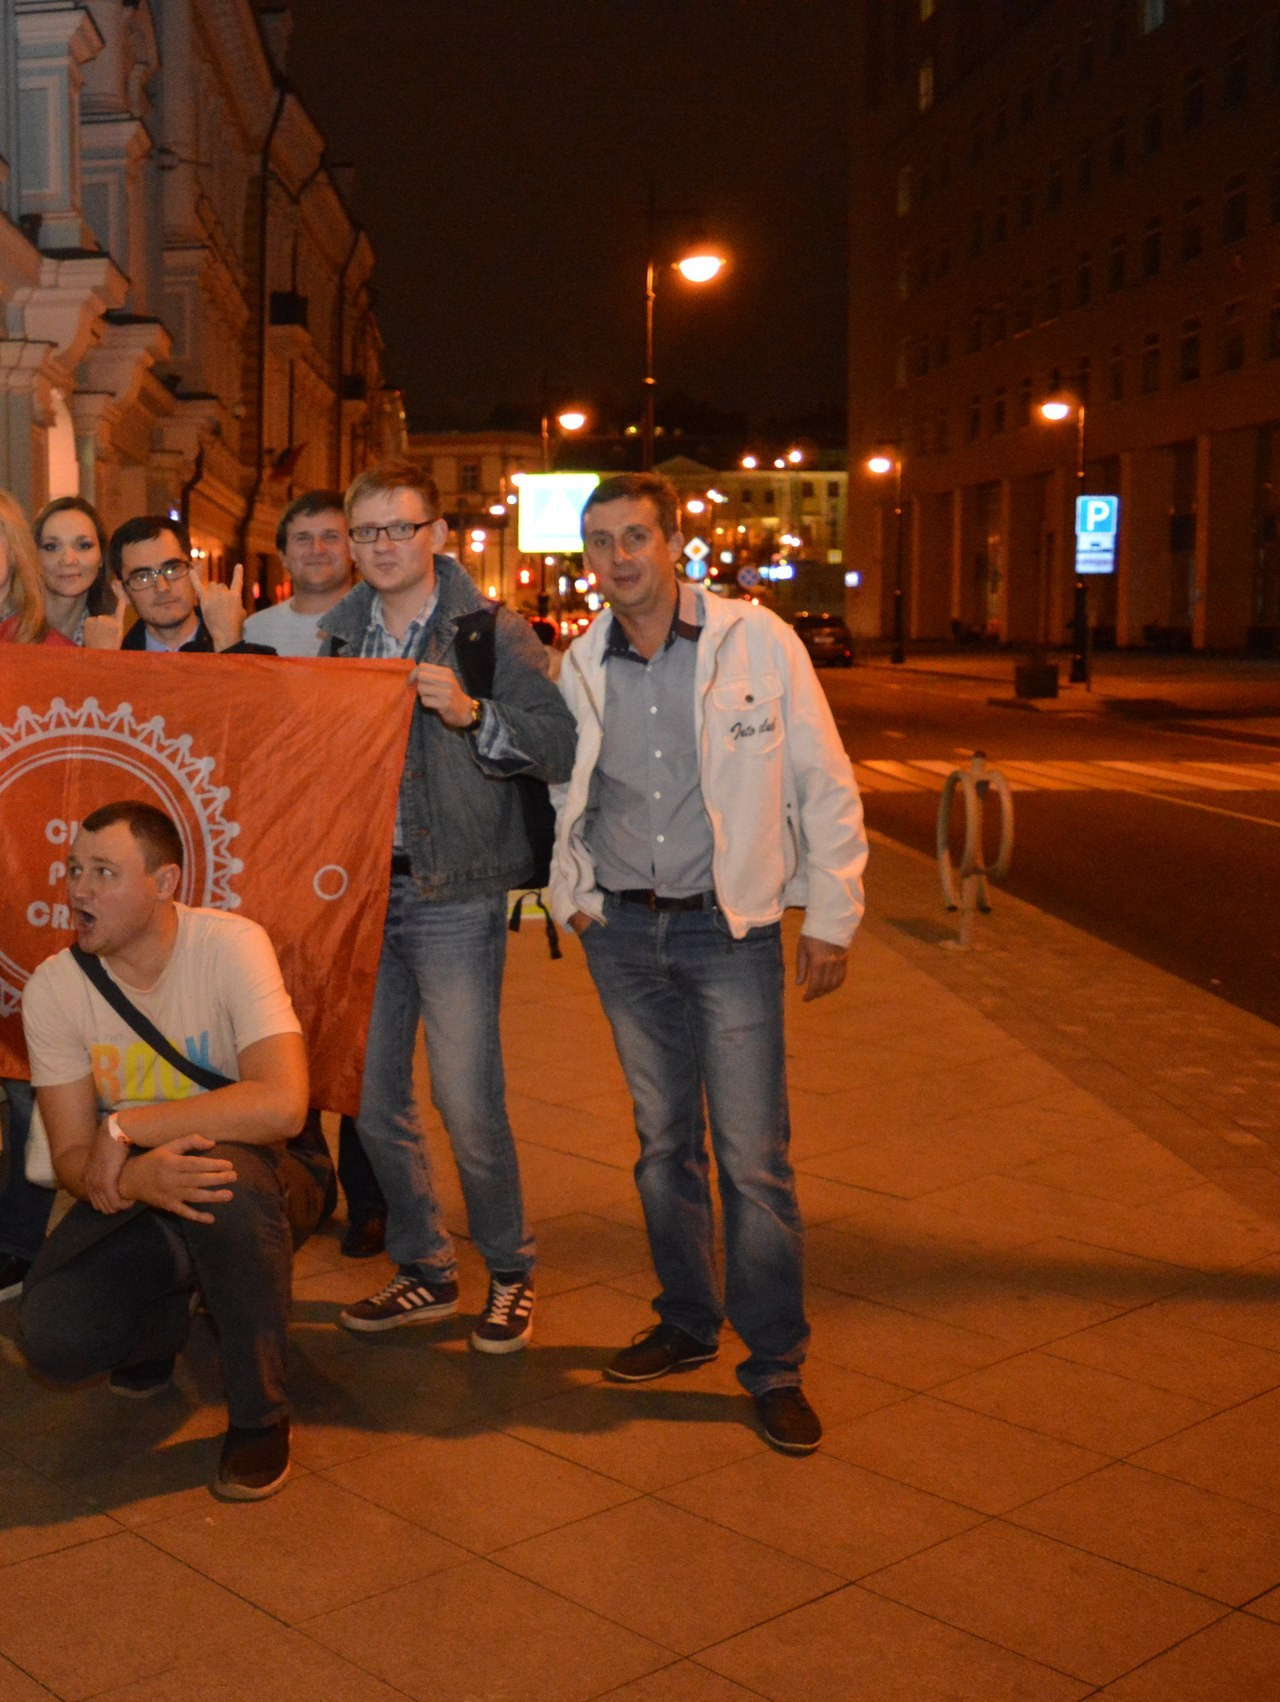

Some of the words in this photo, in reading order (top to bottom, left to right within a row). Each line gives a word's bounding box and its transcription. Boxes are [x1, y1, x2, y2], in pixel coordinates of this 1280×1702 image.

[1086, 500, 1110, 532] P
[45, 819, 78, 845] CI
[48, 861, 66, 886] P
[27, 901, 75, 929] CR
